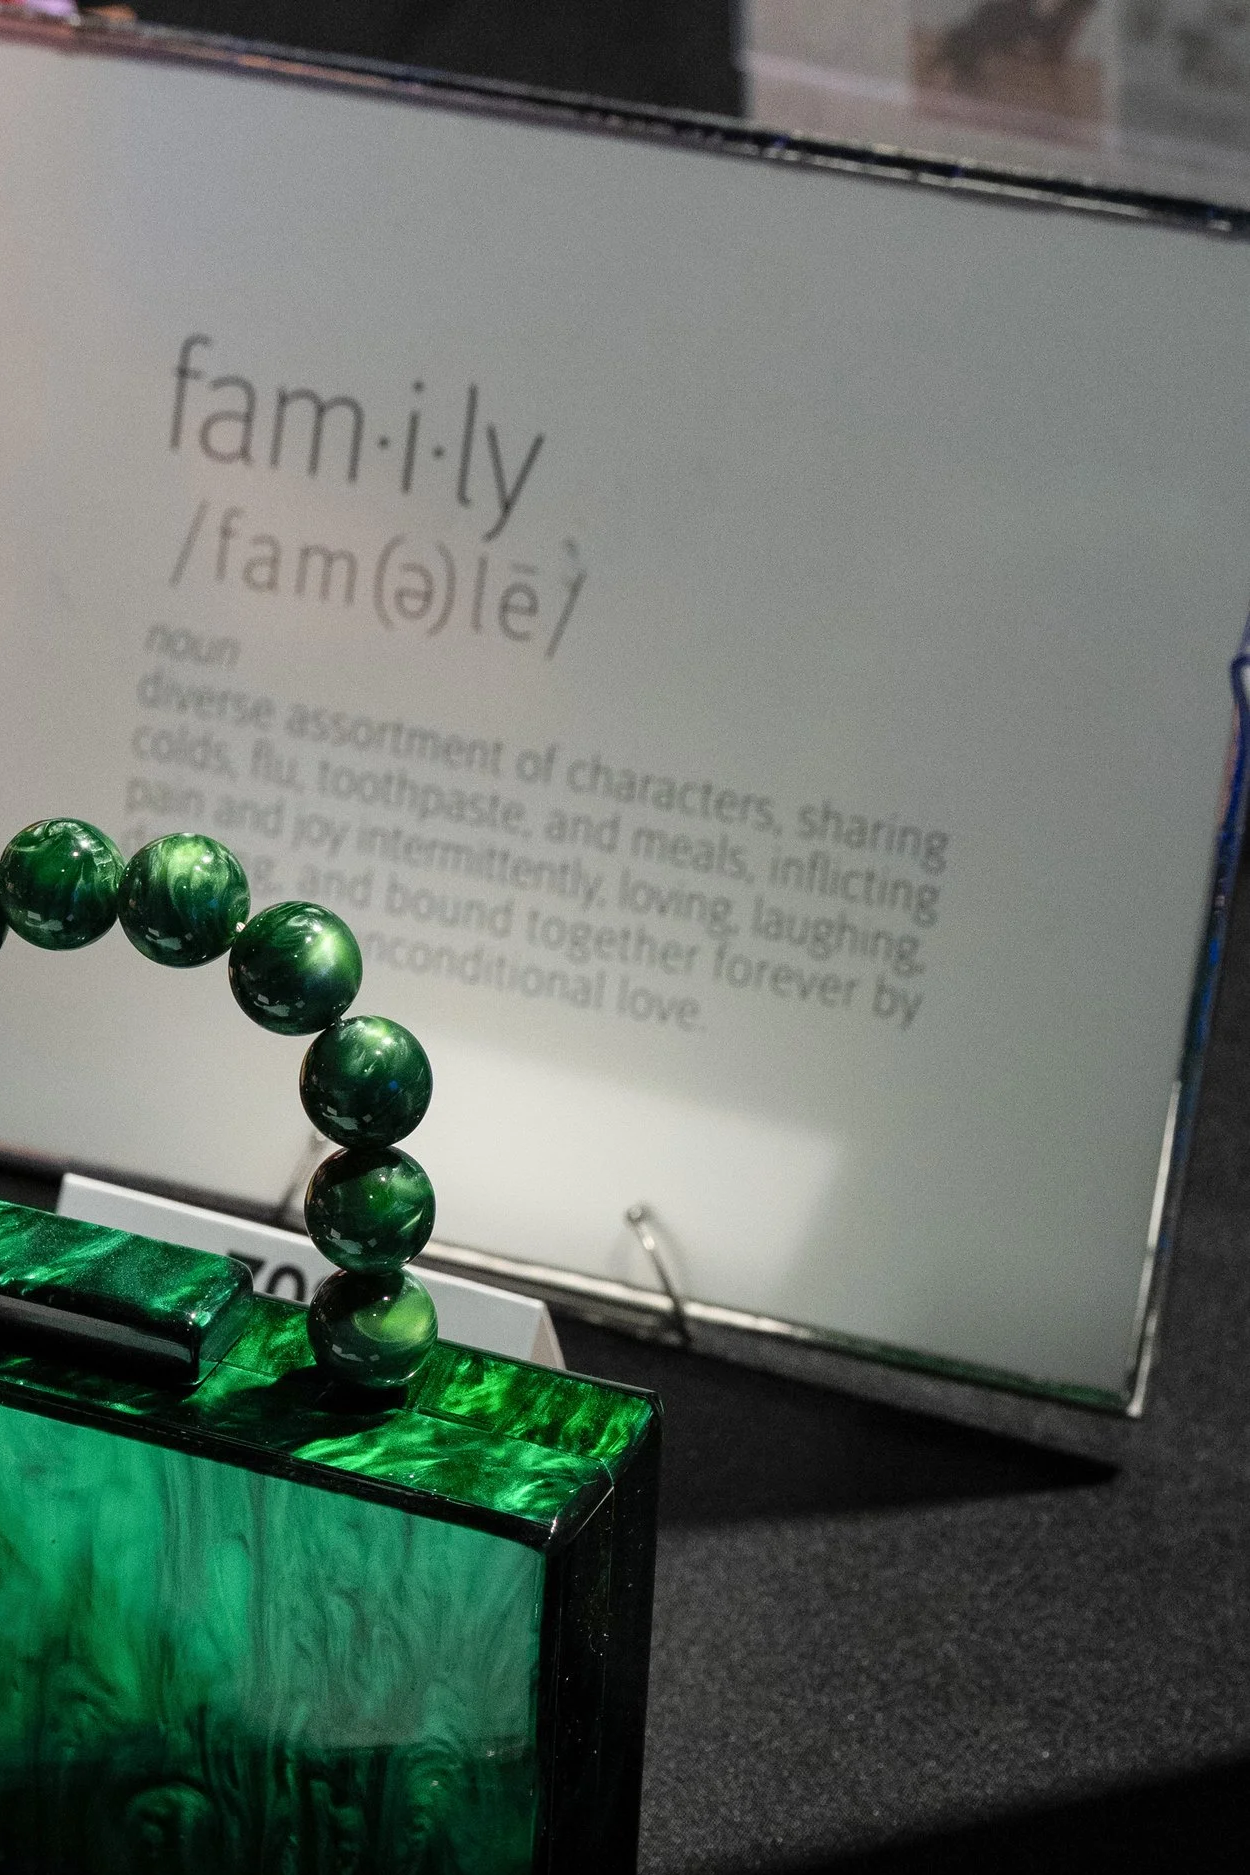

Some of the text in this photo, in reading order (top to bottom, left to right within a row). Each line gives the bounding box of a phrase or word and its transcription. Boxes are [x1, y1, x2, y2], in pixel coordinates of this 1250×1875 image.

[144, 622, 242, 668] noun
[124, 774, 205, 818] pain
[212, 796, 285, 840] and
[292, 810, 352, 860] joy
[137, 667, 276, 730] diverse
[284, 700, 504, 778] assortment
[515, 742, 557, 786] of
[796, 799, 949, 876] sharing
[544, 808, 622, 855] and
[768, 847, 943, 930] inflicting
[299, 862, 376, 909] and
[386, 866, 515, 940] bound
[527, 907, 702, 976] together
[712, 938, 862, 1010] forever
[869, 973, 927, 1032] by
[358, 925, 608, 1012] nconditional
